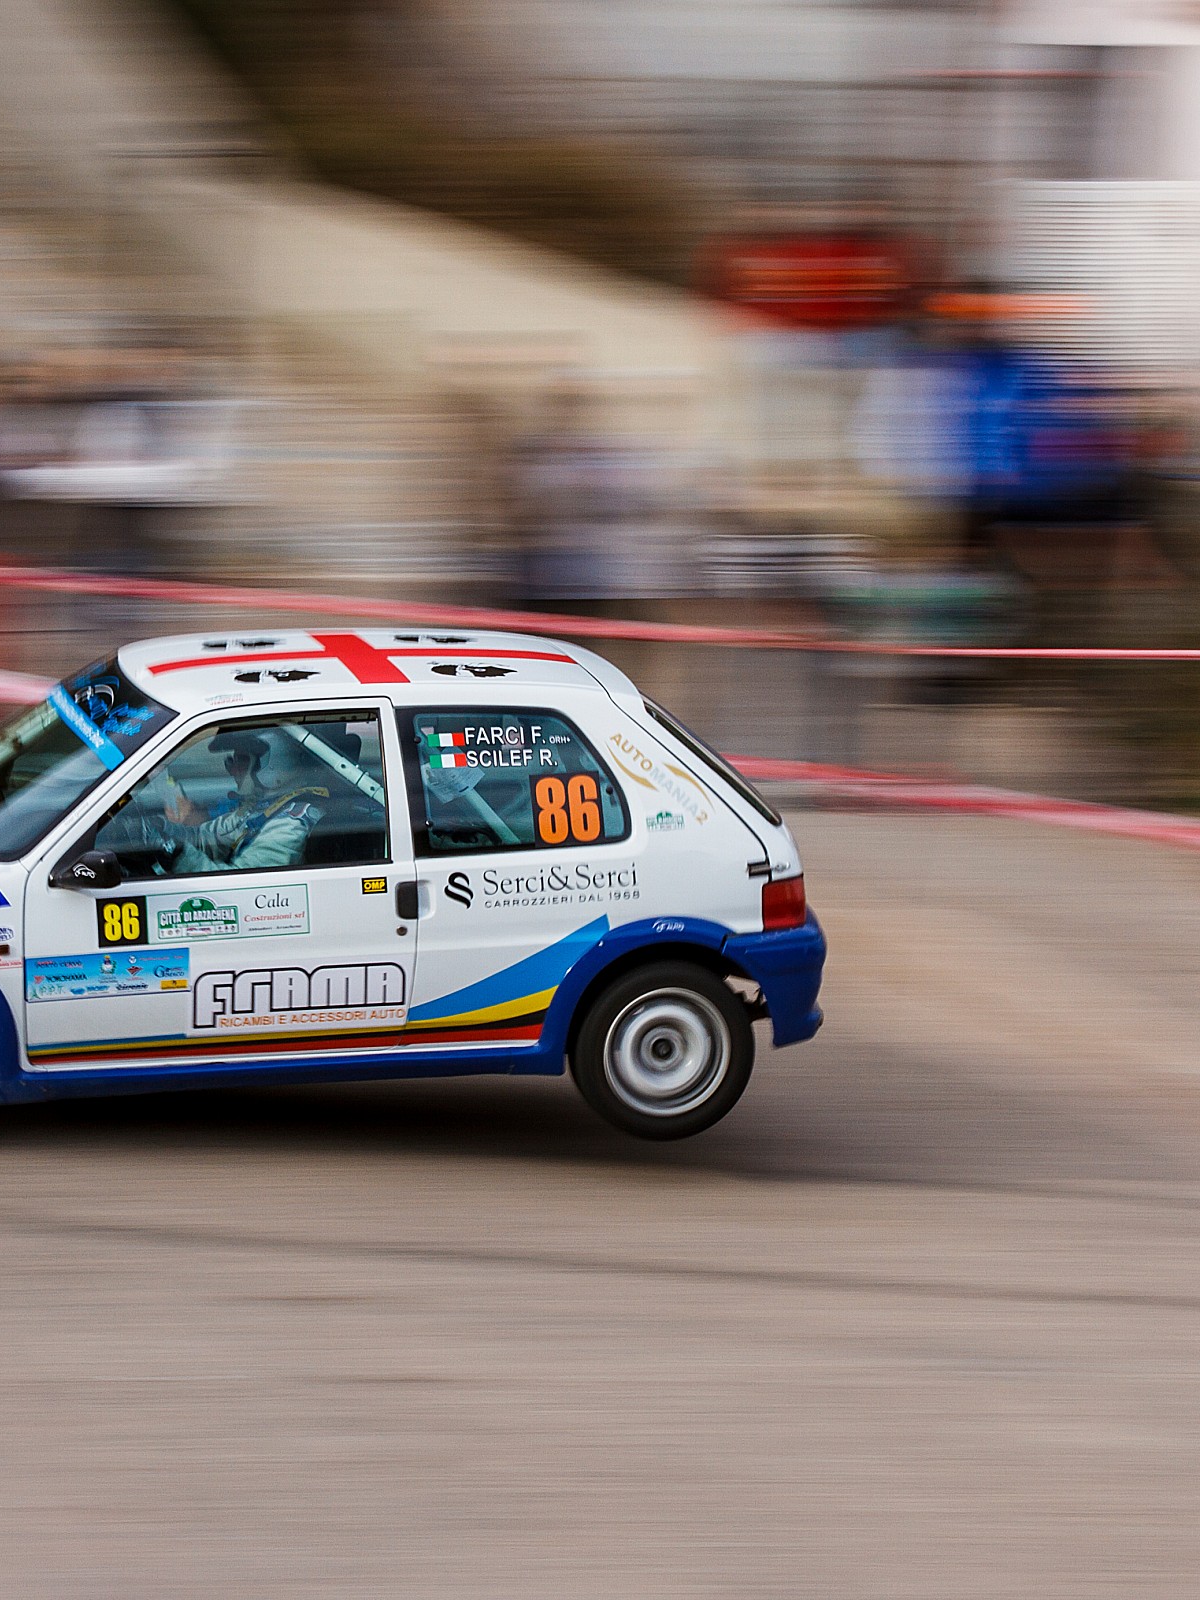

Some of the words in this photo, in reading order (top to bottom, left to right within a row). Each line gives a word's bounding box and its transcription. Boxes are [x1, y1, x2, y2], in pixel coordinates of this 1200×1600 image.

[464, 726, 525, 745] FARCI
[531, 725, 546, 744] F.
[466, 748, 534, 768] SCILEF
[540, 748, 558, 767] R.
[535, 774, 601, 844] 86
[363, 880, 386, 891] OMP
[482, 861, 638, 896] Serci&Serci
[254, 893, 290, 910] Cala
[484, 894, 573, 909] CARROZZIERI
[579, 893, 603, 903] DAL
[609, 890, 641, 901] 1968
[102, 902, 141, 942] 86
[183, 910, 192, 922] DI
[192, 908, 236, 922] ARZACHENA
[243, 910, 292, 923] Costruzioni
[219, 1011, 275, 1028] RICAMBI
[278, 1012, 287, 1024] E
[291, 1008, 367, 1025] ACCESSORI
[369, 1007, 406, 1020] AUTO
